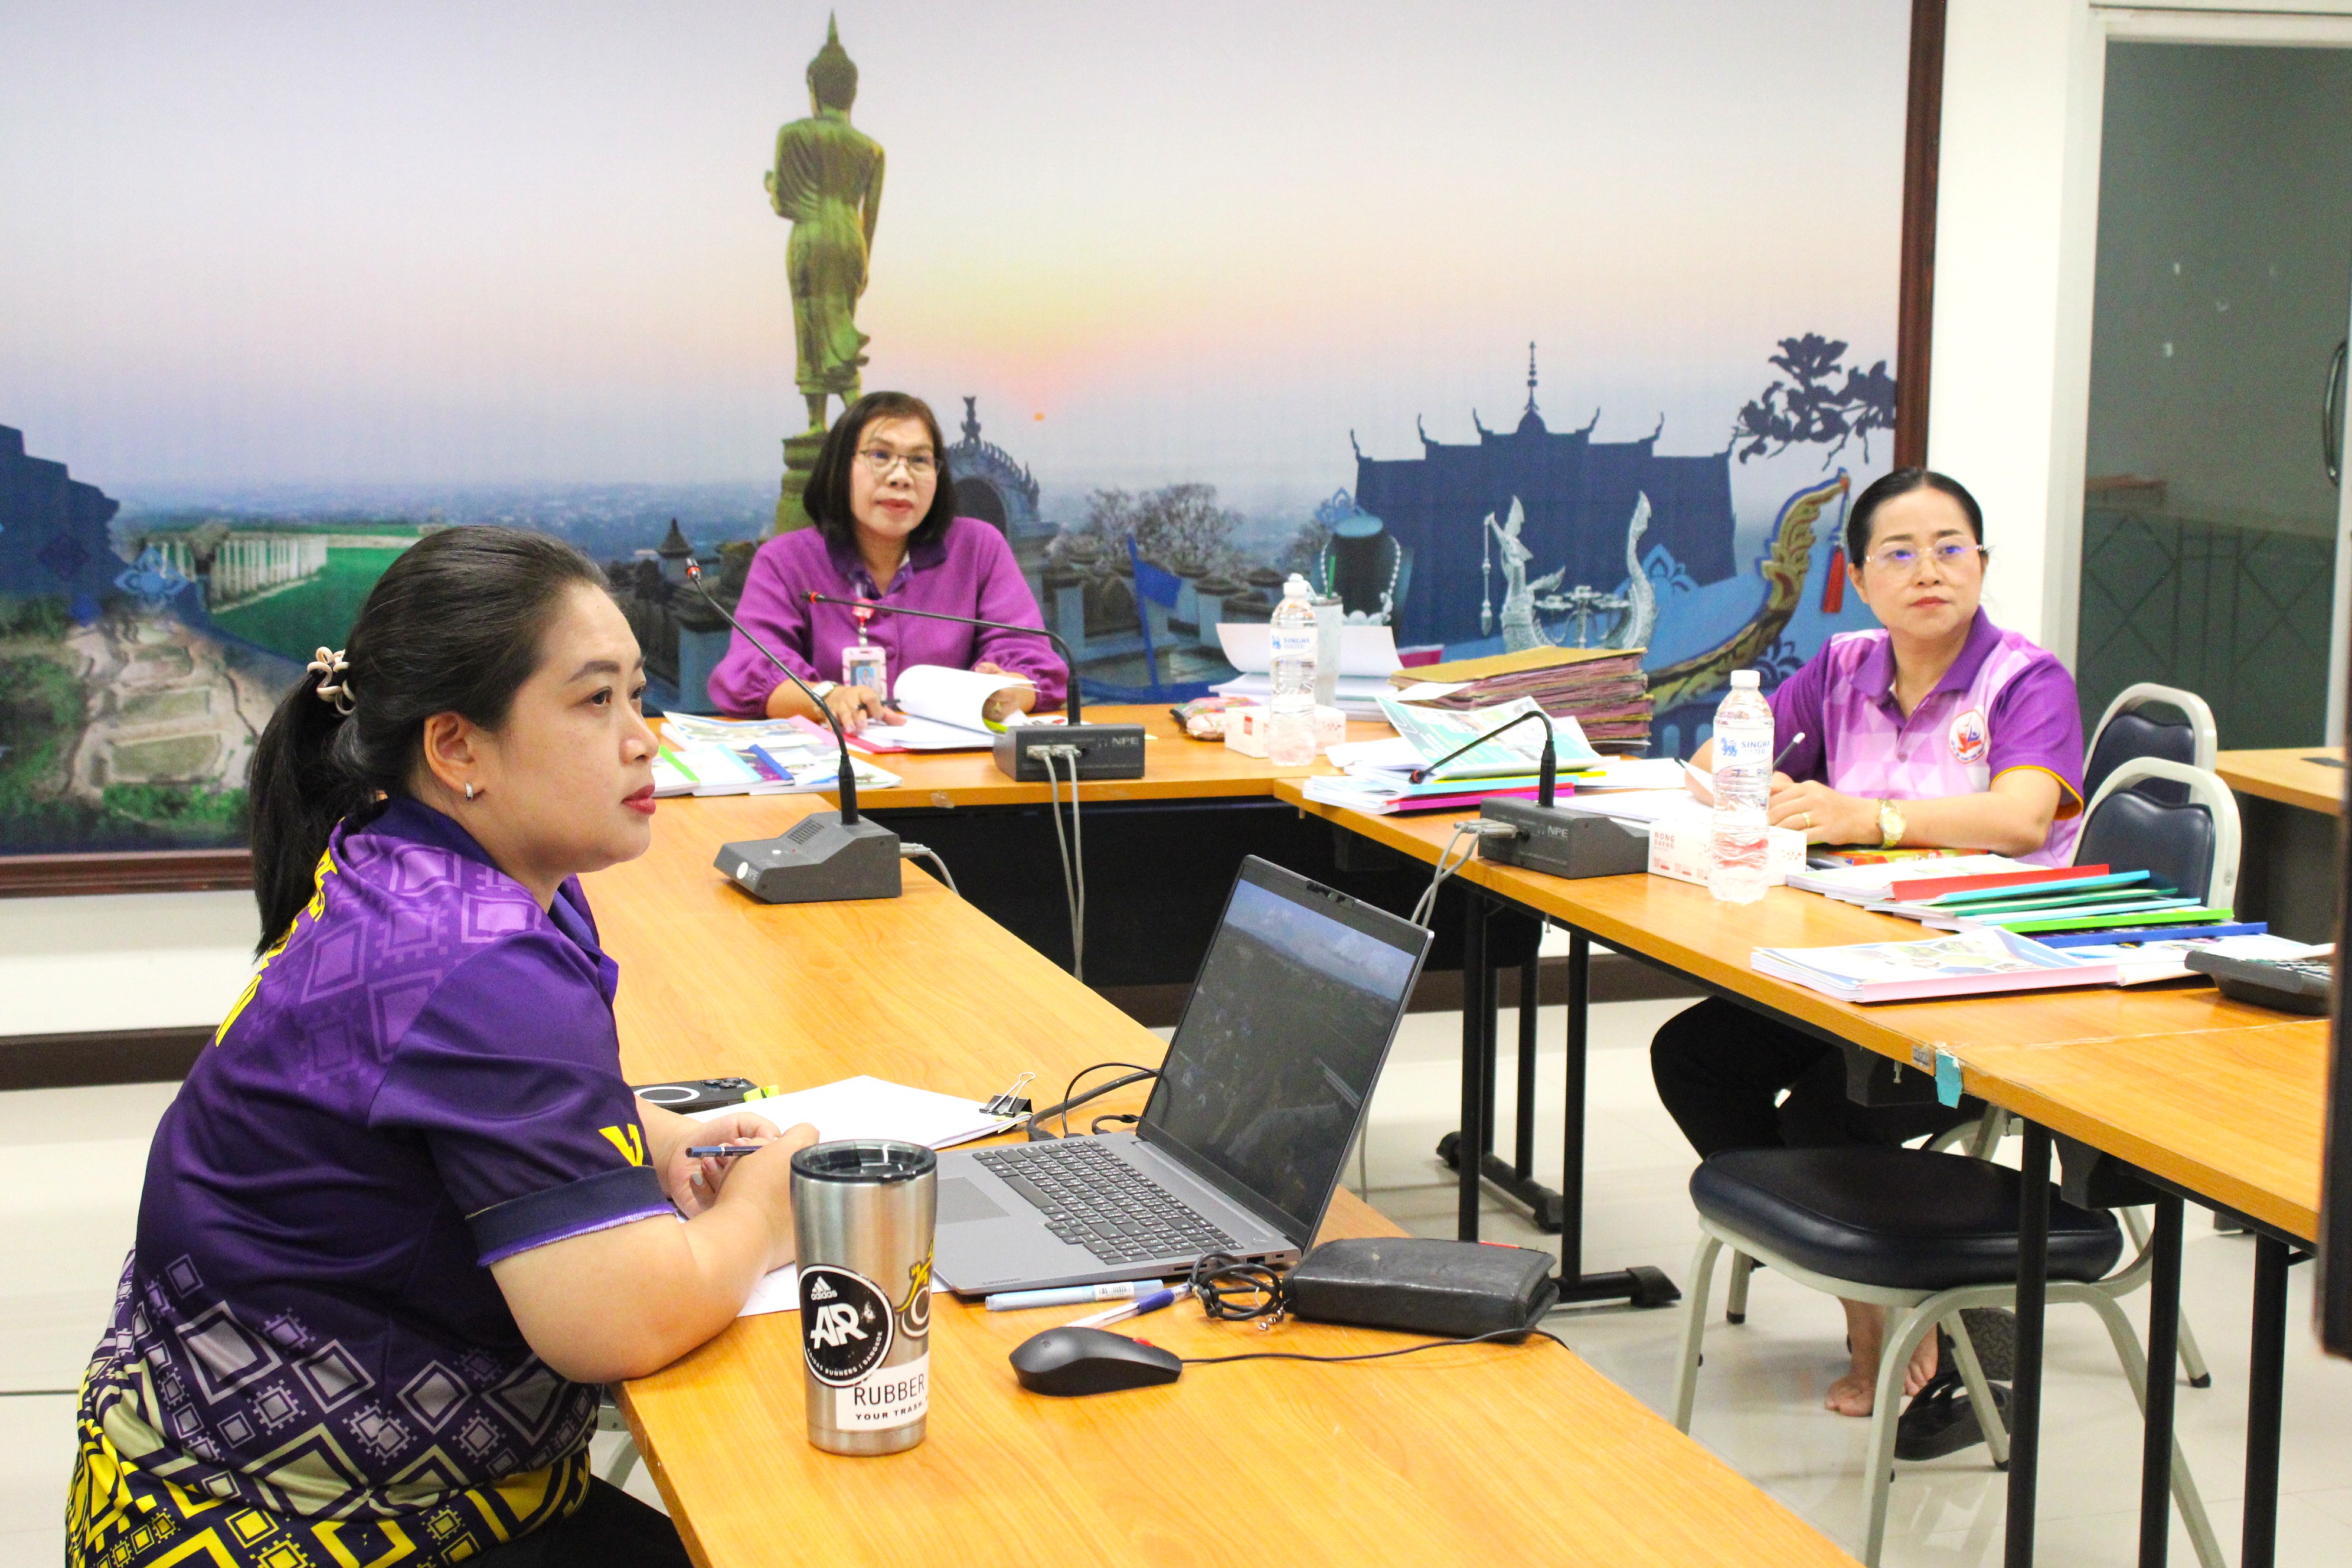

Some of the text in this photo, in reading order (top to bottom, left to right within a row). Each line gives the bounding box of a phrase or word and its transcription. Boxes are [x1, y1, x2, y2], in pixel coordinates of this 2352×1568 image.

[1741, 740, 1770, 749] SINGHA
[1548, 825, 1569, 838] NPE
[1654, 831, 1675, 842] NONG
[1654, 839, 1674, 849] DAENG
[811, 1289, 838, 1301] adidas
[854, 1373, 925, 1406] RUBBER
[856, 1412, 888, 1420] YOUR
